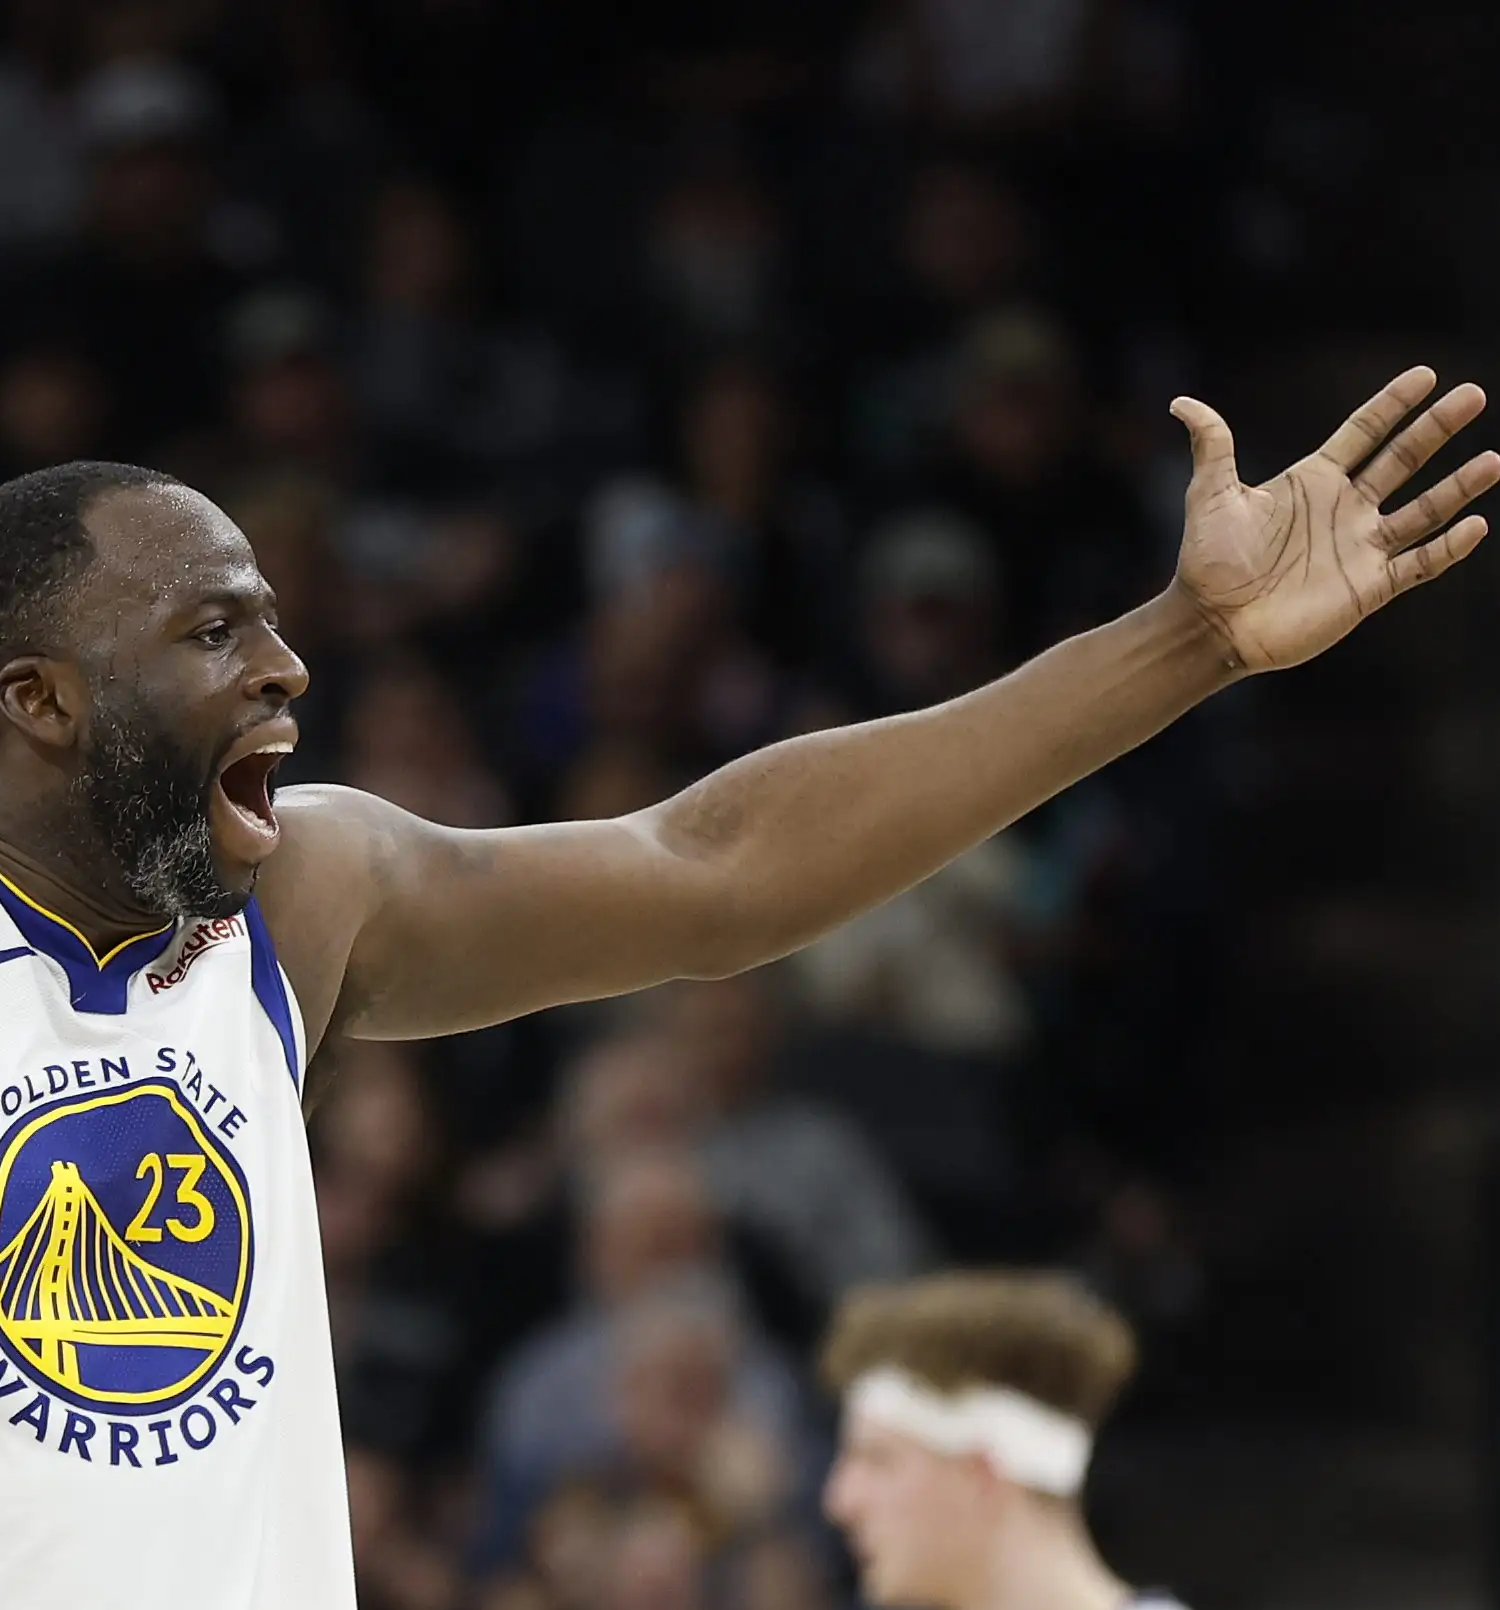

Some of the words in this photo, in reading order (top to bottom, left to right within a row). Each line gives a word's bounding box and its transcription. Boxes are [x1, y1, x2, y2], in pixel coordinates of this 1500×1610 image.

[146, 916, 244, 994] Rakuten
[156, 1047, 247, 1139] STATE
[124, 1152, 215, 1243] 23
